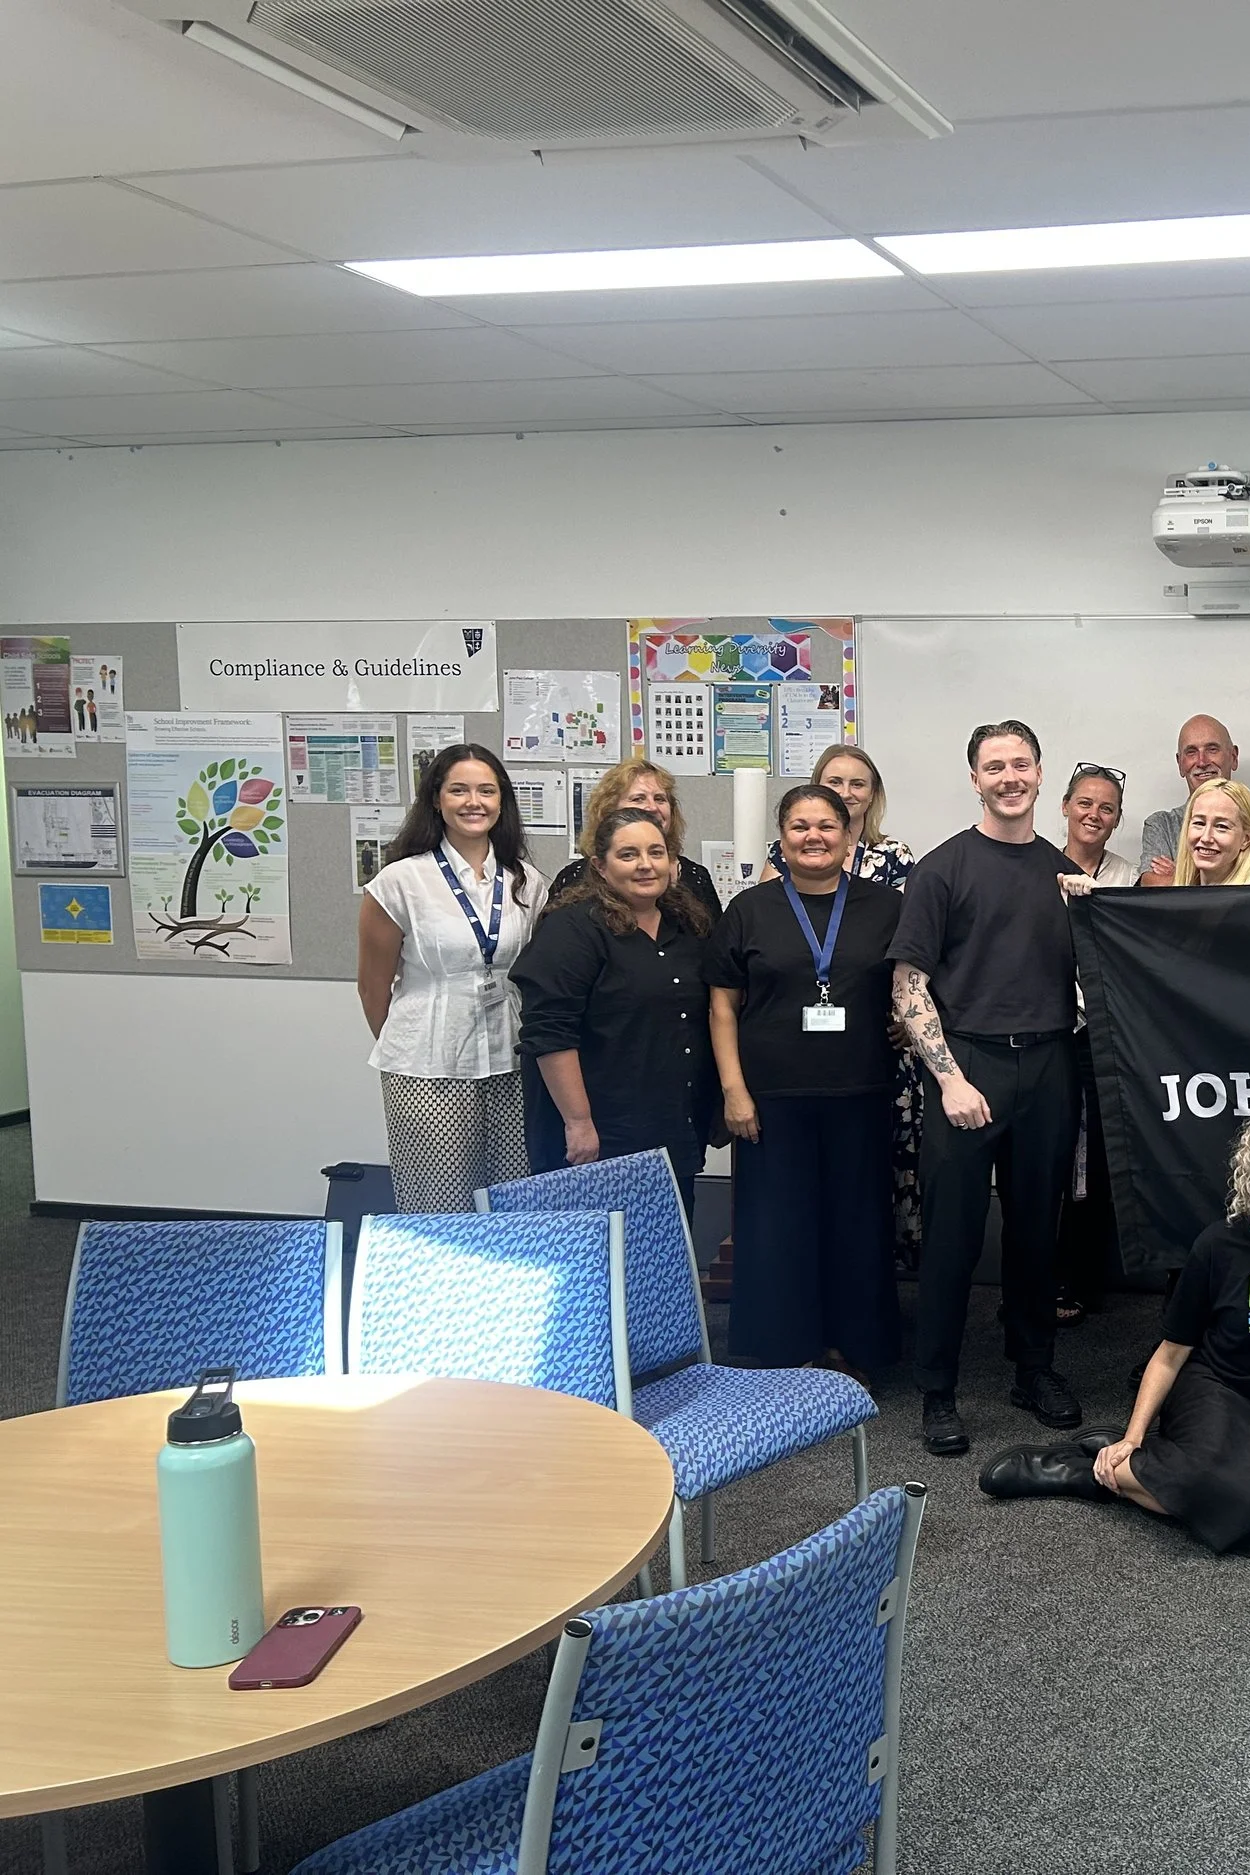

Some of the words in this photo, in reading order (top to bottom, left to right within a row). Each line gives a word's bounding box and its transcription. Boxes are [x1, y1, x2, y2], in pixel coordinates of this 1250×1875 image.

[665, 642, 724, 656] Learning
[730, 642, 787, 658] Diversity
[209, 658, 325, 681] Compliance
[332, 659, 349, 676] &
[354, 658, 462, 677] Guidelines
[710, 661, 744, 673] News
[781, 704, 788, 716] 1
[781, 717, 788, 729] 2
[805, 717, 812, 729] 3
